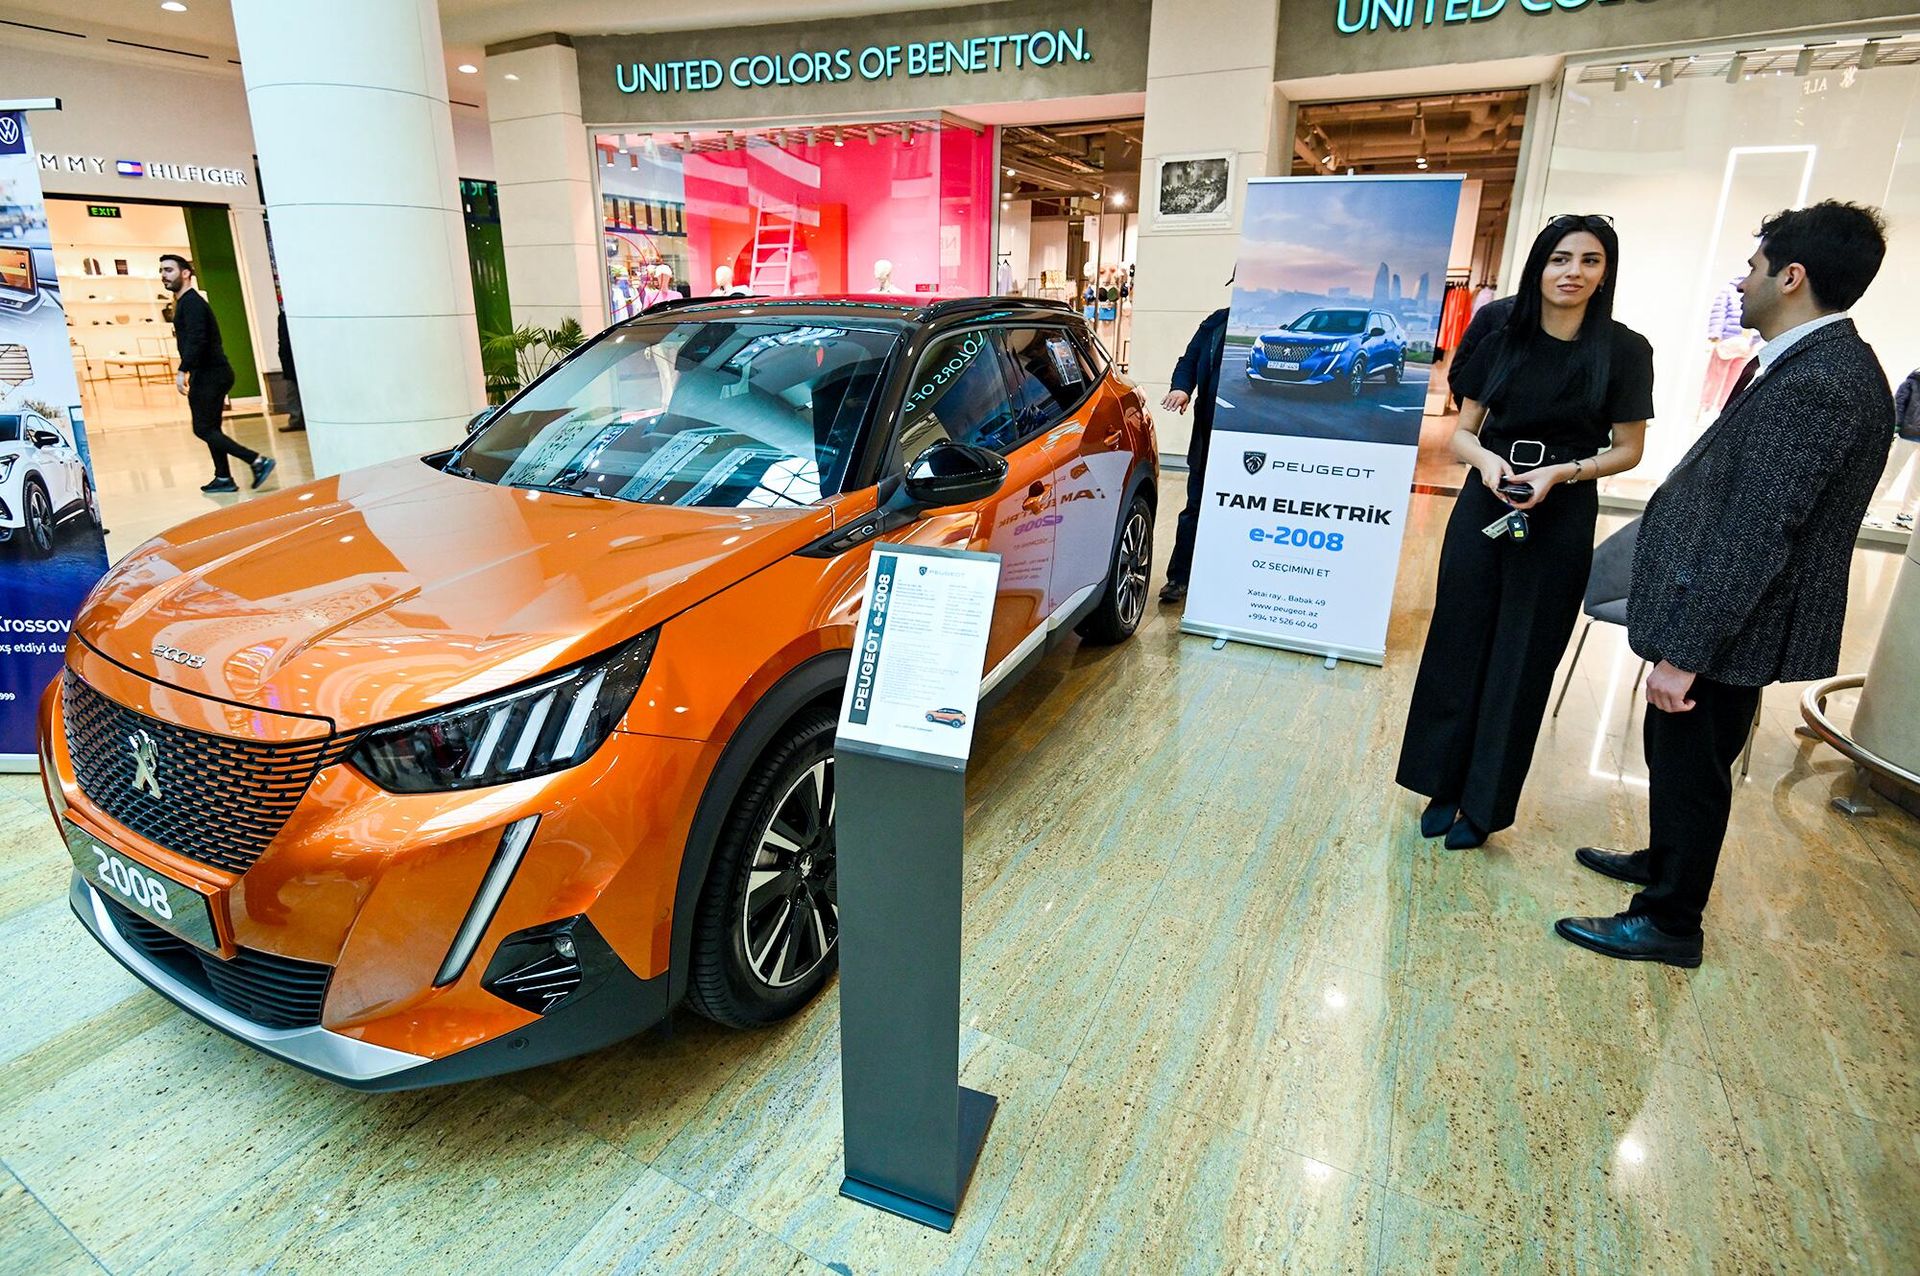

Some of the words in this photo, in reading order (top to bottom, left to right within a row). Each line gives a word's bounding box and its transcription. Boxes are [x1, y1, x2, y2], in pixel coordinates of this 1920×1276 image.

[616, 58, 724, 93] UNITED
[729, 48, 852, 88] COLORS
[858, 45, 901, 80] OF
[907, 27, 1092, 76] BENETTON.
[40, 153, 105, 173] MMY
[149, 162, 248, 187] HILFIGER
[91, 207, 118, 217] EXIT
[1272, 460, 1375, 479] PEUGEOT
[1216, 491, 1267, 512] TAM
[1272, 498, 1393, 526] ELEKTRİK
[1249, 526, 1344, 552] e-2008
[1316, 568, 1331, 578] ET
[1315, 599, 1326, 607] 49
[1269, 615, 1278, 623] 12
[1279, 617, 1294, 626] 526
[1295, 620, 1306, 628] 40
[1307, 621, 1318, 630] 40
[13, 642, 47, 655] etdiyi
[854, 628, 880, 711] PEUGEOT
[873, 573, 891, 627] e-2008
[150, 643, 206, 669] 2008
[91, 844, 173, 920] 2008
